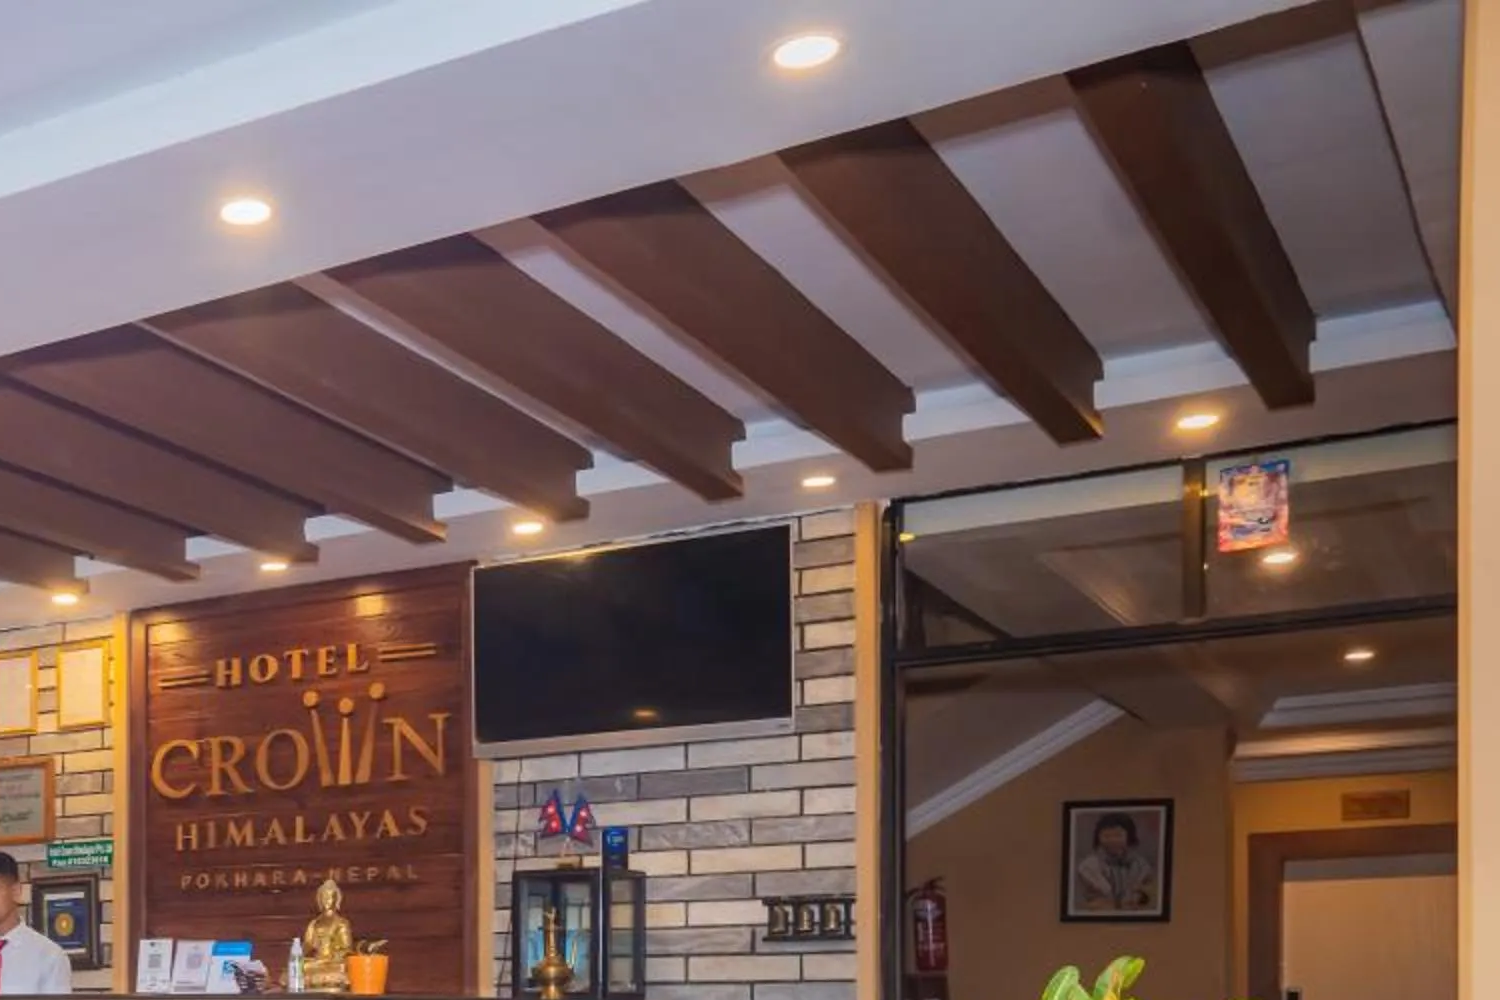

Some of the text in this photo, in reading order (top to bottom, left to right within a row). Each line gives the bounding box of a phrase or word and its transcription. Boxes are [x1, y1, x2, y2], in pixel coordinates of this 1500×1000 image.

[215, 644, 369, 687] HOTEL
[151, 683, 451, 798] CROWN
[176, 805, 428, 851] HIMALAYAS
